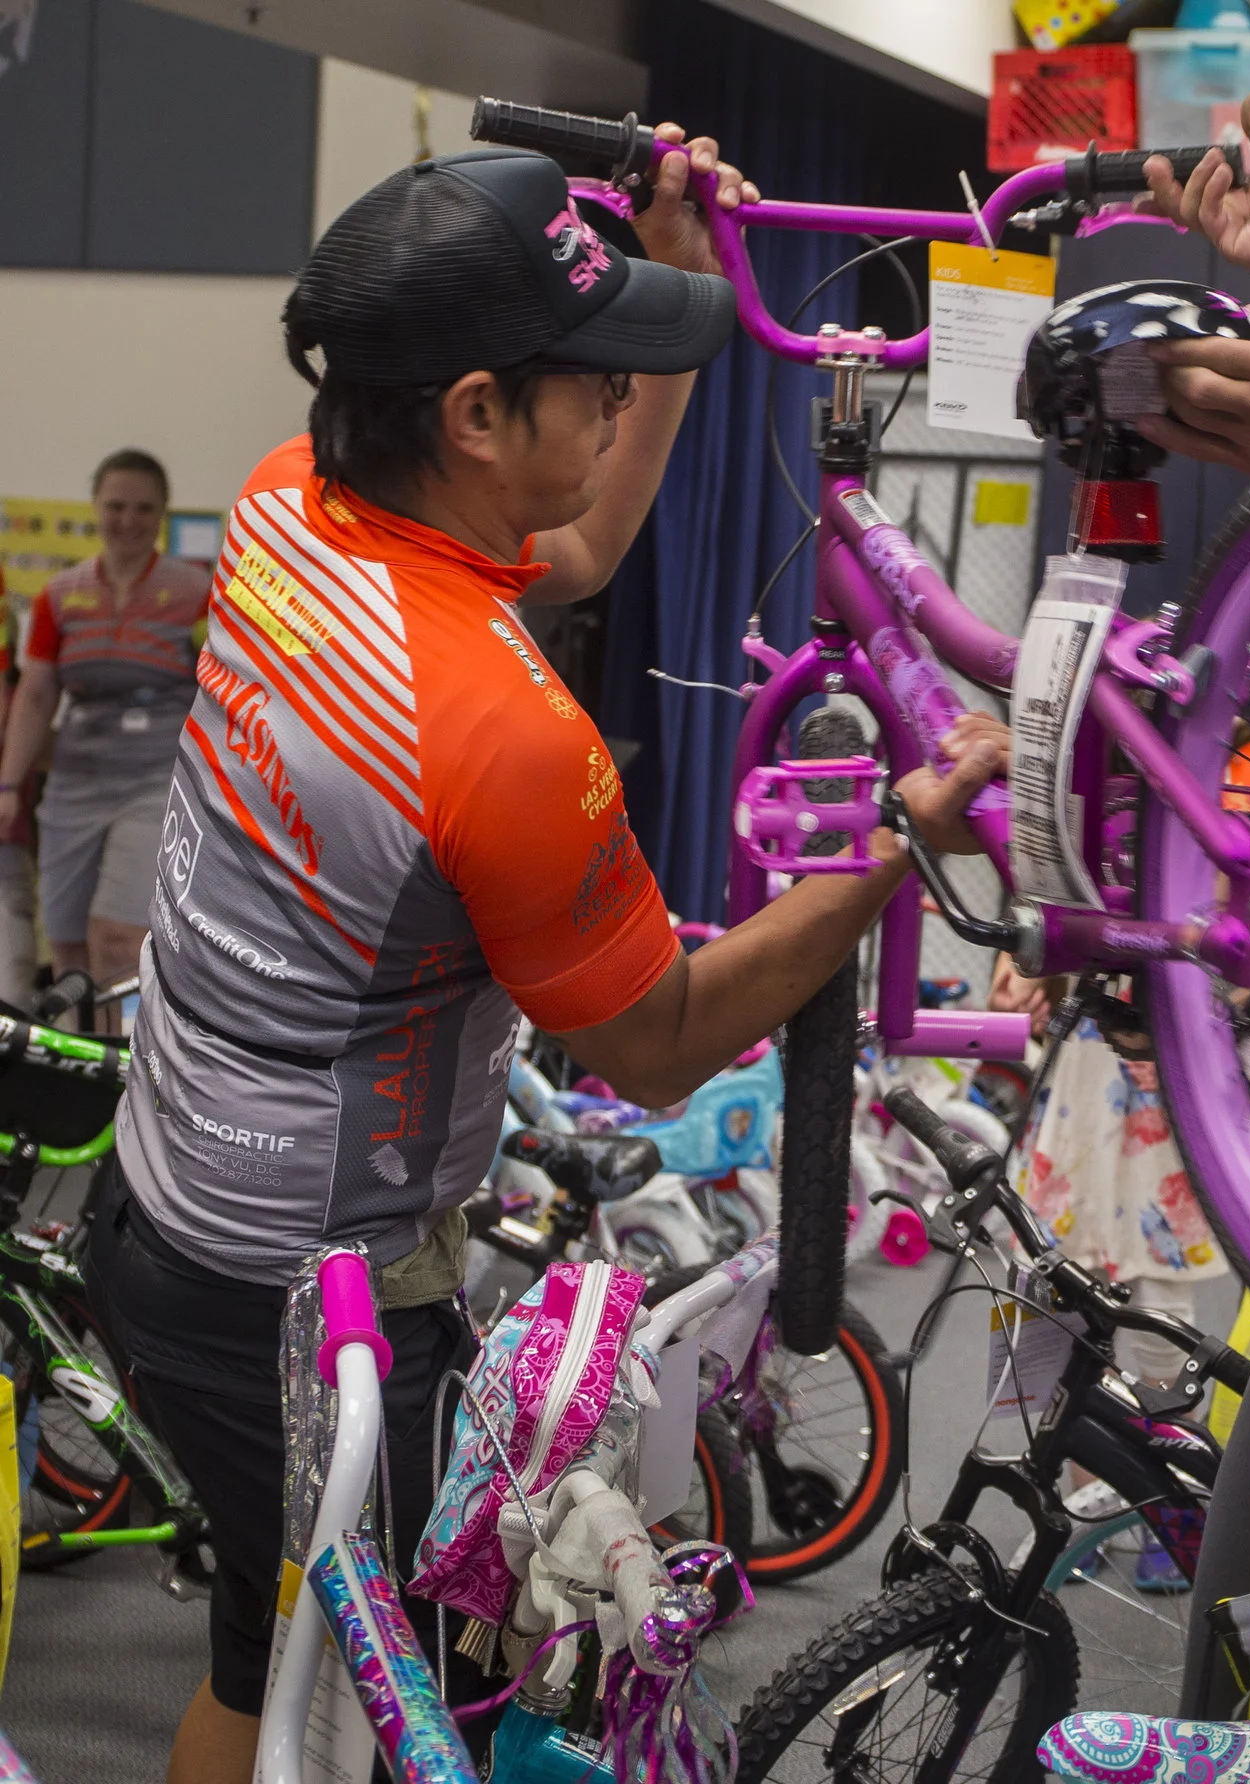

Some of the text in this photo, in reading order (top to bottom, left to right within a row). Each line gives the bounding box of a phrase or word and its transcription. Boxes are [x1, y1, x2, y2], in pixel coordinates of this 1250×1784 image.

[235, 540, 345, 653] BREAKAWAY
[225, 681, 325, 877] CASINOS
[580, 785, 600, 811] LAS
[192, 1113, 295, 1153] SPORTIF
[198, 1134, 284, 1163] CHIROPRACTIC
[198, 1146, 230, 1166] TONY
[1147, 1436, 1201, 1450] BYTE
